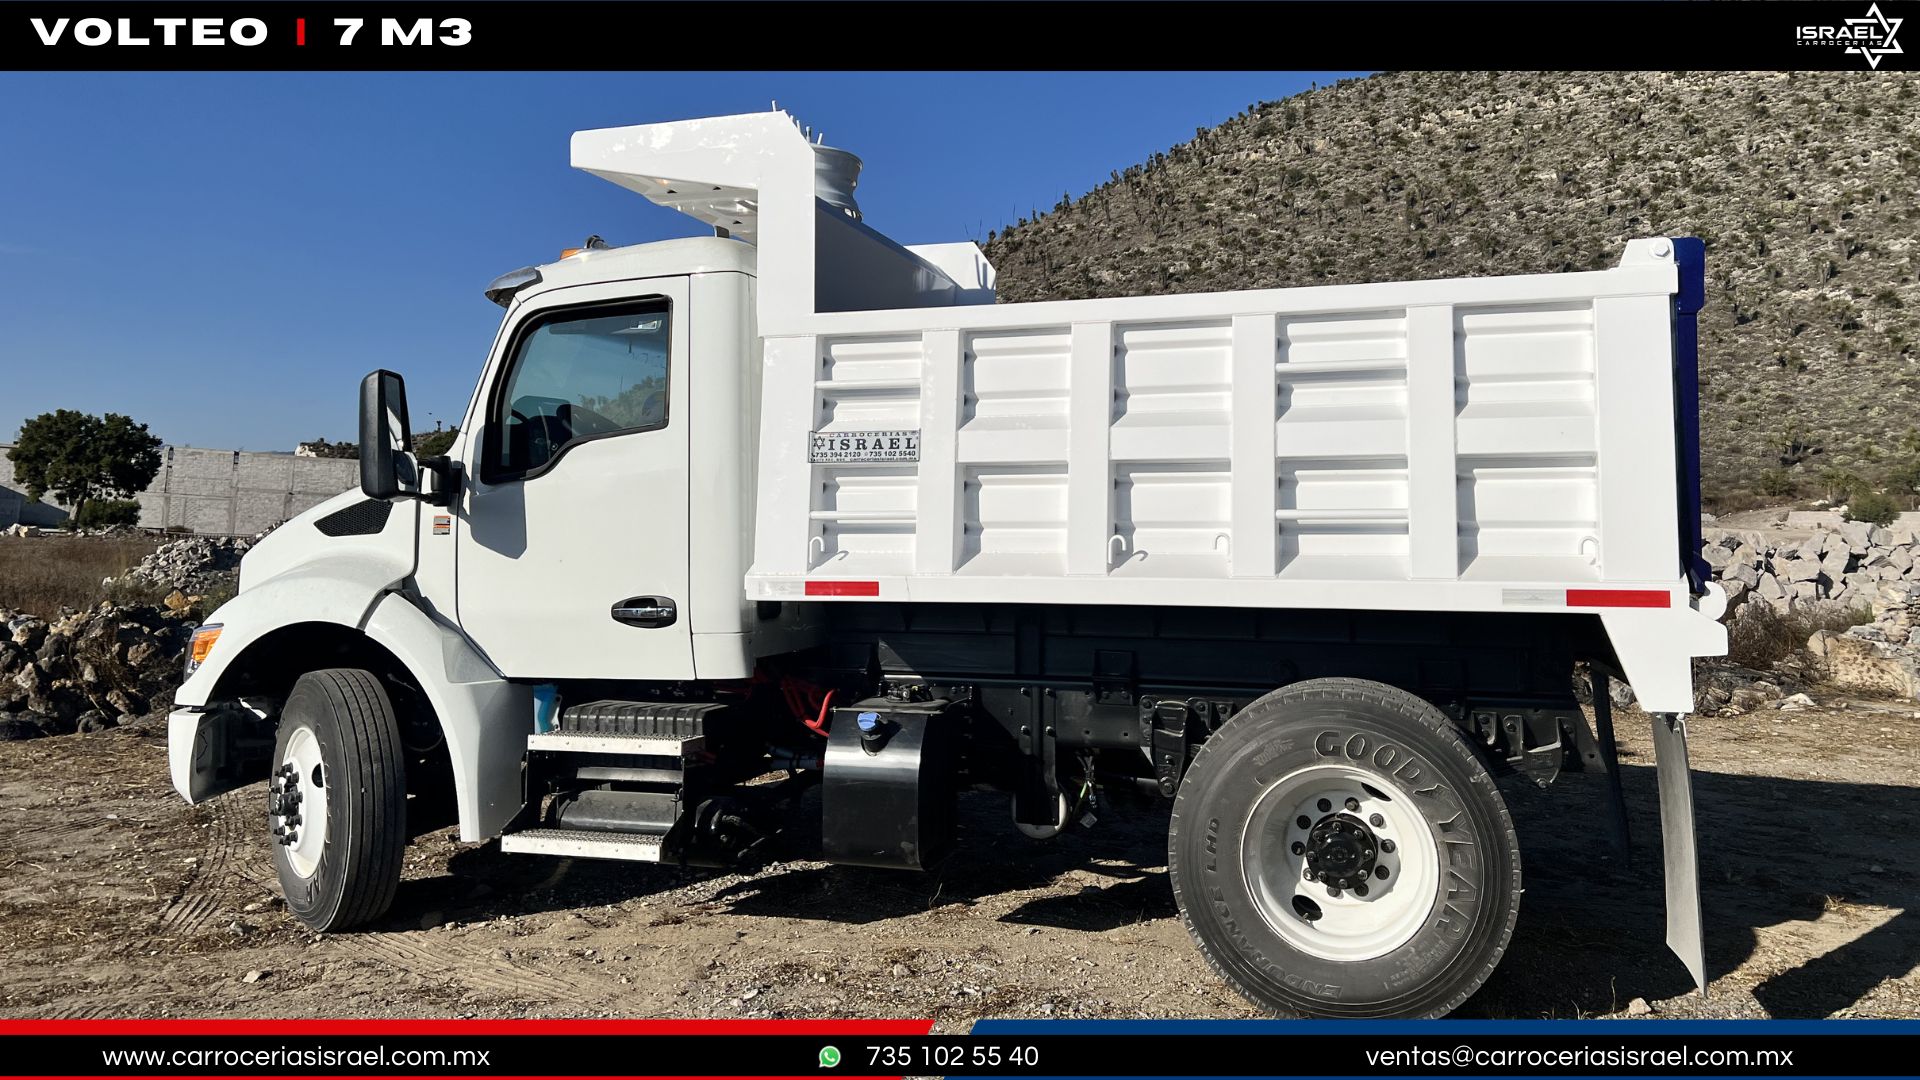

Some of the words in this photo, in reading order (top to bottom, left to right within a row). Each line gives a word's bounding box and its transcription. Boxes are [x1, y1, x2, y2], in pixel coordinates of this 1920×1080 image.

[827, 437, 916, 451] ISRAEL
[1204, 817, 1221, 874] LHD
[1314, 729, 1479, 941] GOODYEAR
[1209, 886, 1343, 999] ENDURANCE
